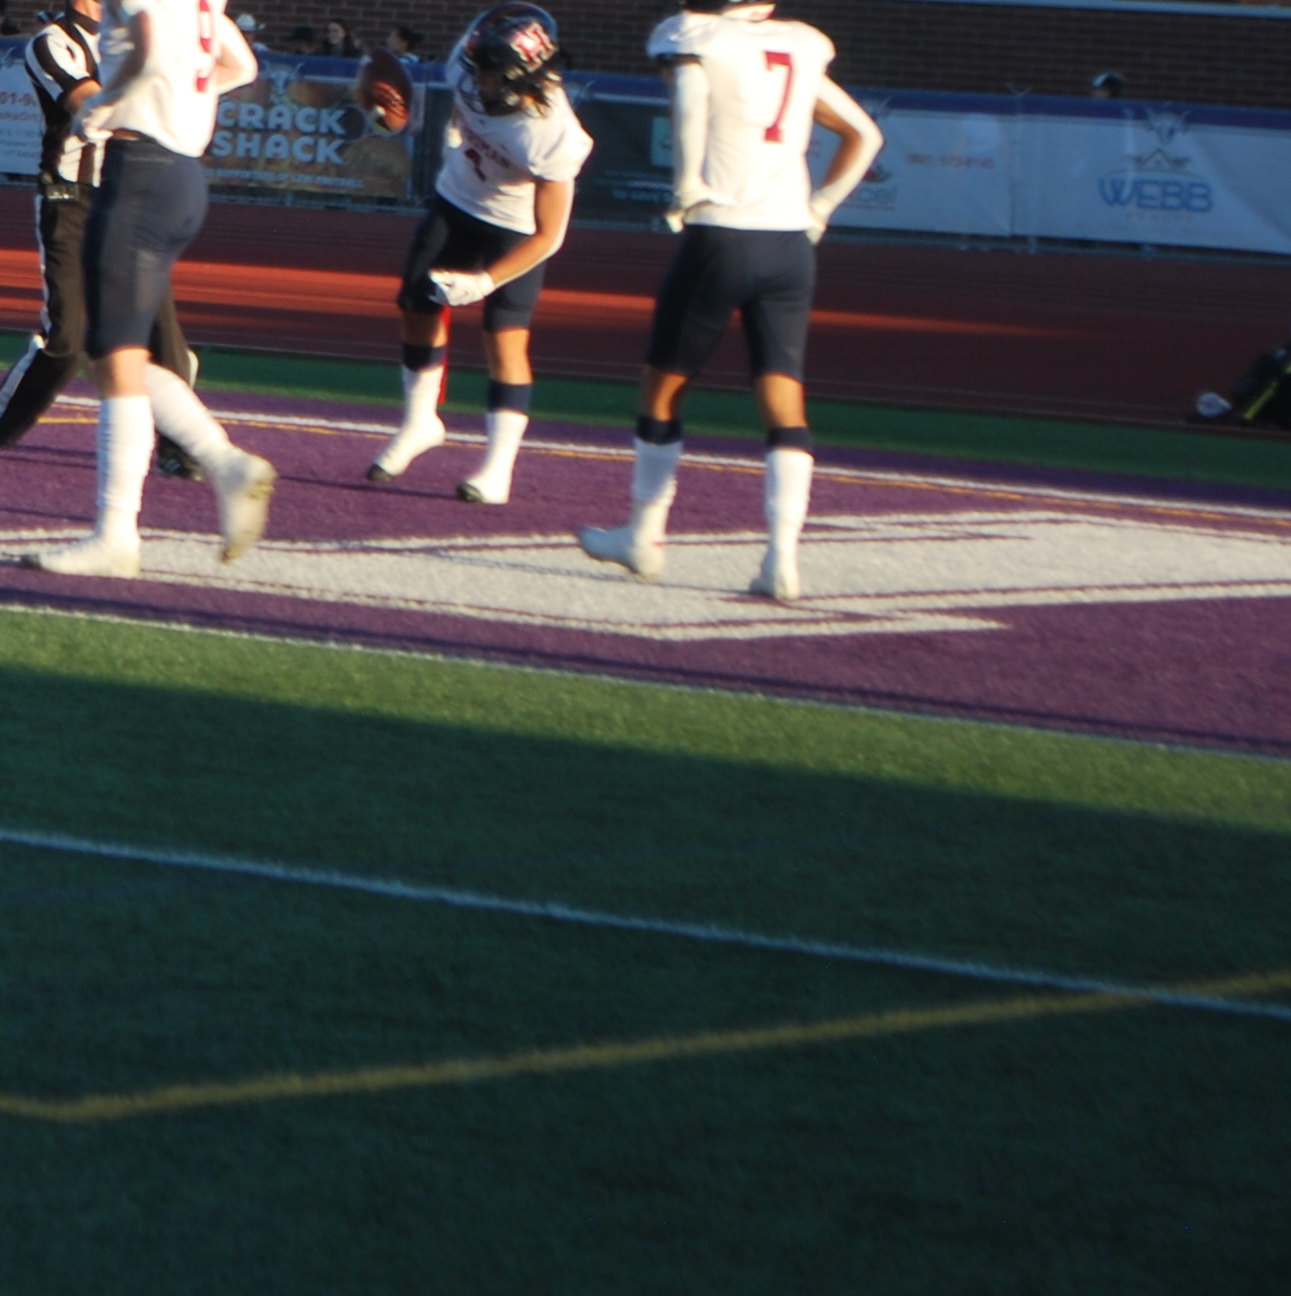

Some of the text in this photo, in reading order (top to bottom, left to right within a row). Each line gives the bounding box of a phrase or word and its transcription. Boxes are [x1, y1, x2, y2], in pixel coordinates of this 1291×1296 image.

[763, 50, 793, 143] 7
[217, 101, 347, 135] CRACK
[211, 130, 343, 165] SHACK
[1098, 176, 1214, 212] WEBB
